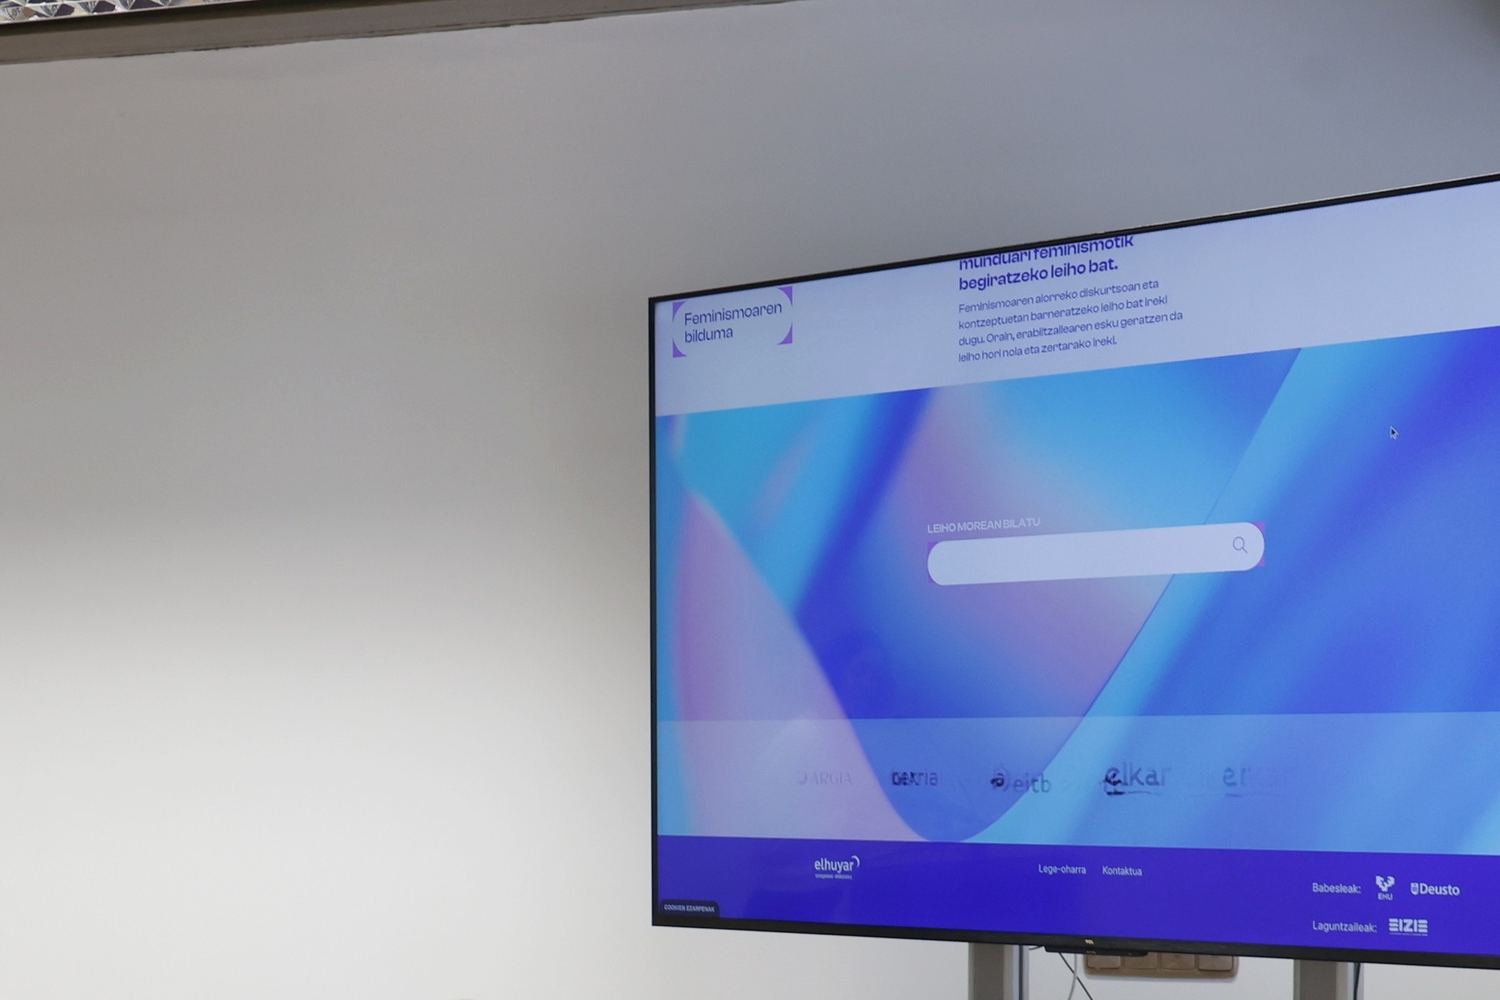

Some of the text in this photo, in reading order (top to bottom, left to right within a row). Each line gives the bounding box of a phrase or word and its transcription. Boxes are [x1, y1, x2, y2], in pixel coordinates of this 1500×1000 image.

[959, 258, 1119, 291] begiratzeko leiho bat.
[958, 280, 1160, 313] Feminismoaren alorreko diskurtsoan eta
[684, 303, 782, 325] Feminismoaren
[958, 295, 1168, 330] kontzeptuetan barneratzeko leiho bat ireki
[986, 331, 1015, 343] Orain,
[1094, 319, 1119, 330] esku
[1120, 313, 1168, 329] geratzen
[1169, 311, 1183, 321] da
[684, 328, 734, 343] bilduma
[958, 352, 980, 362] leiho
[981, 349, 1001, 360] hori
[1002, 347, 1023, 358] nola
[1024, 345, 1040, 355] eta
[1041, 339, 1092, 353] zertarako
[927, 523, 957, 534] LEIHO
[1003, 517, 1041, 529] BILATU
[814, 857, 854, 873] elhuyar
[1038, 864, 1086, 875] Lege-oharra
[1102, 865, 1143, 877] Kontaktua
[1312, 882, 1361, 894] Babesleak:
[1419, 882, 1460, 896] Deusto
[1312, 920, 1377, 933] Laguntzaileak:
[1389, 918, 1428, 933] EIZIE
